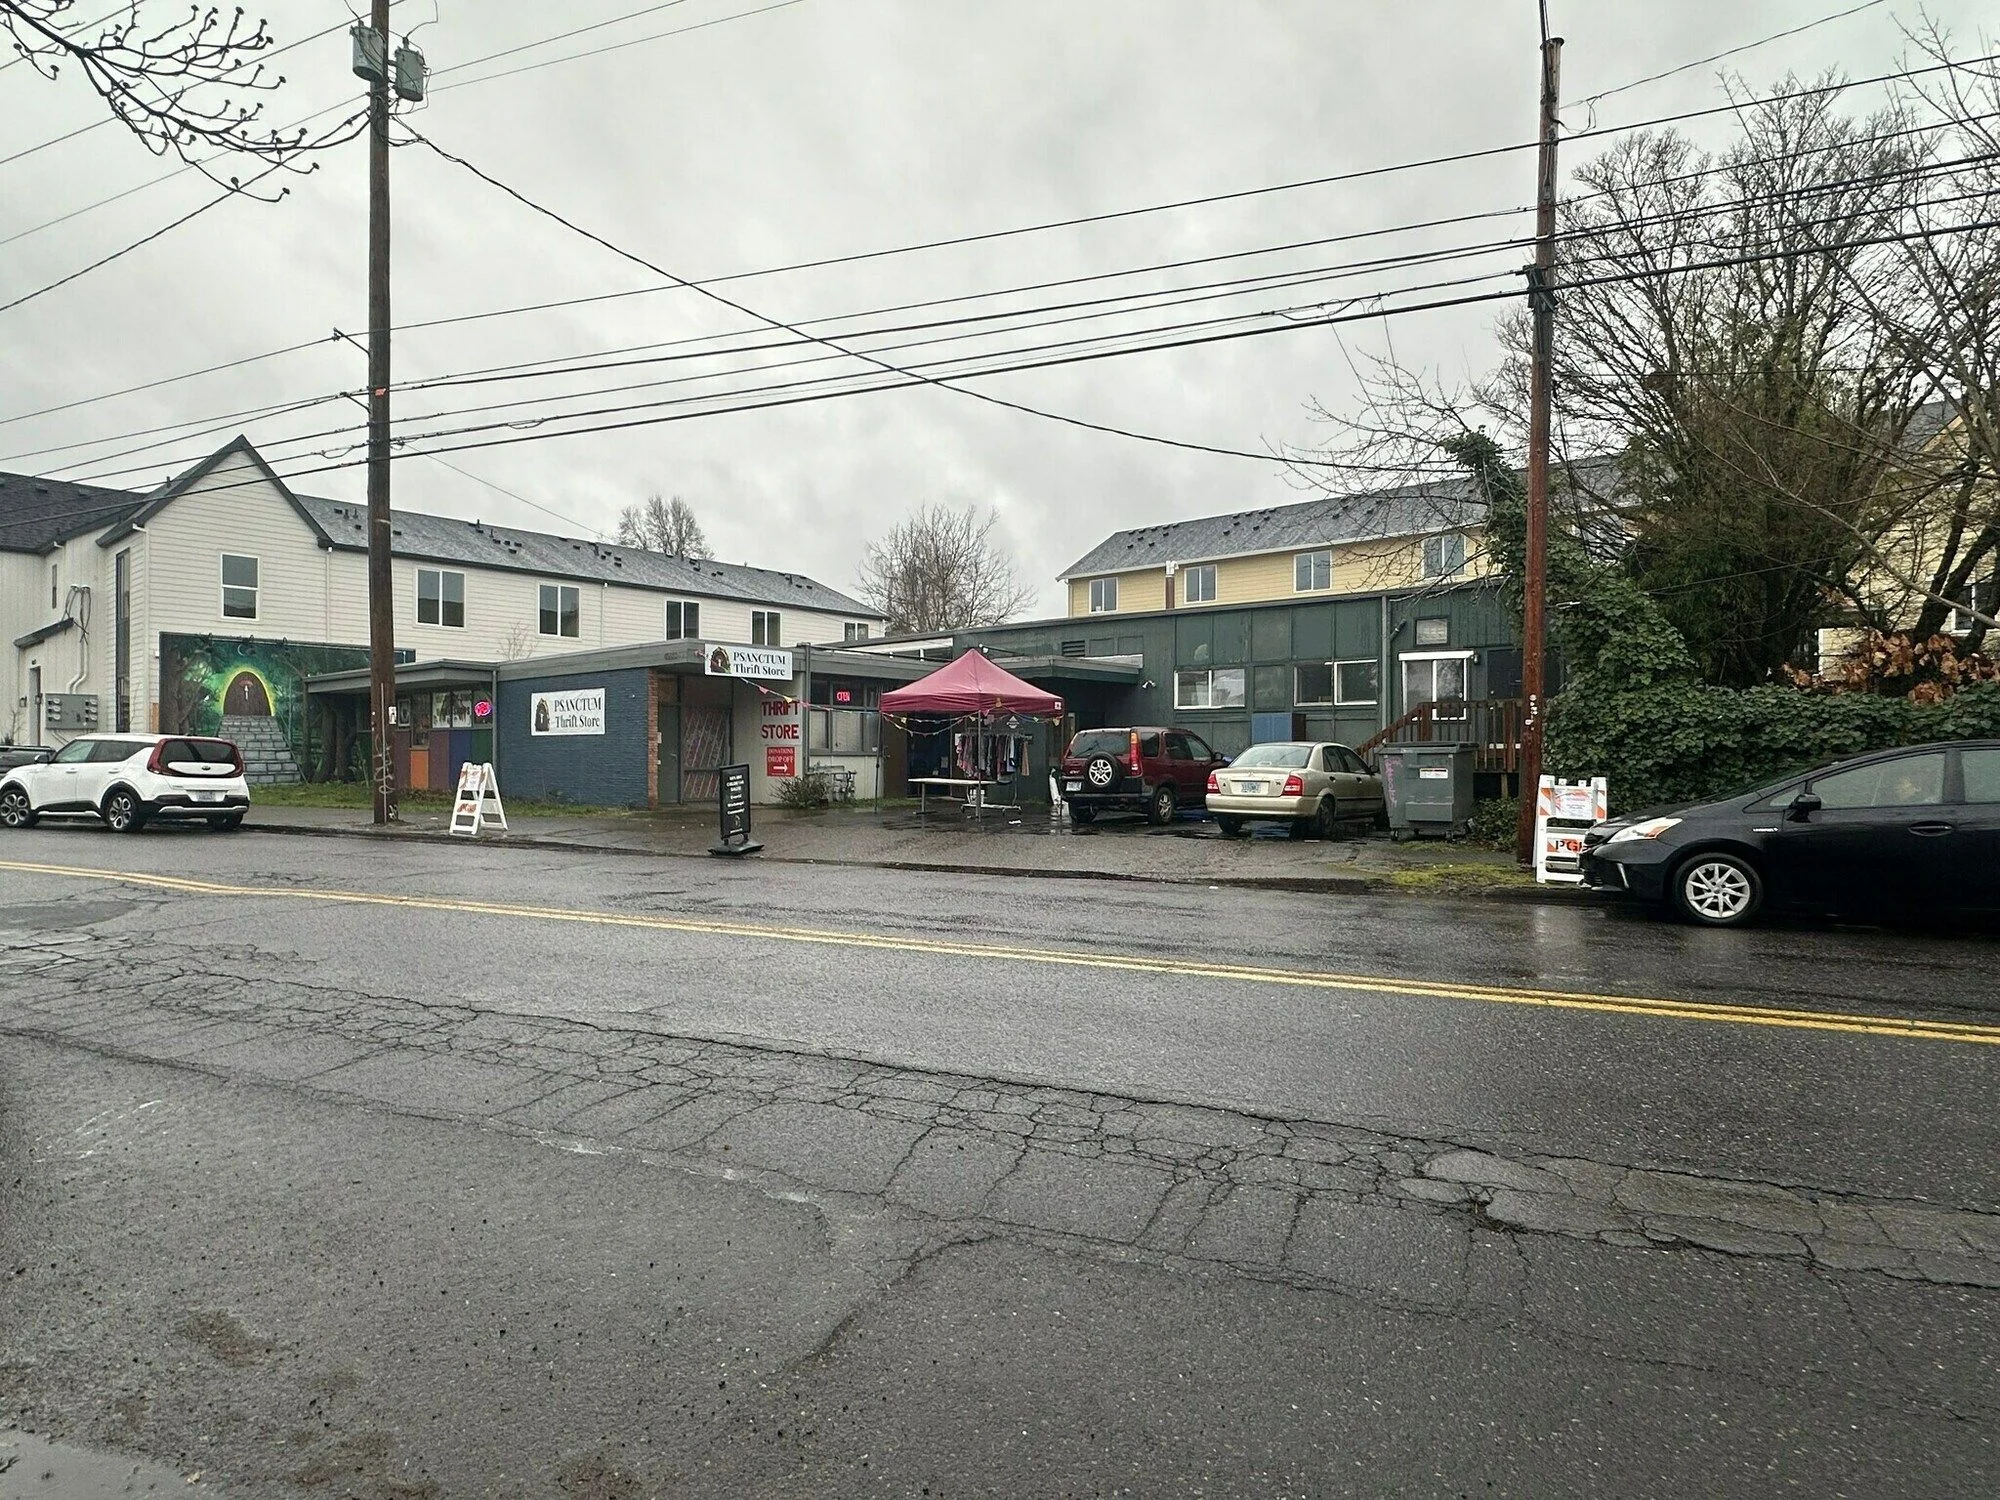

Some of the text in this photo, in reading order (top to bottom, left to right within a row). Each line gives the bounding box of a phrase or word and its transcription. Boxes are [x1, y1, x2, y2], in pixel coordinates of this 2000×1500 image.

[733, 652, 786, 664] PSANCTUM
[733, 663, 786, 676] Thrift Store
[554, 697, 602, 712] PSANCTUM
[761, 700, 800, 716] THRIFT
[555, 714, 600, 728] Thrift Store
[761, 724, 799, 739] STORE
